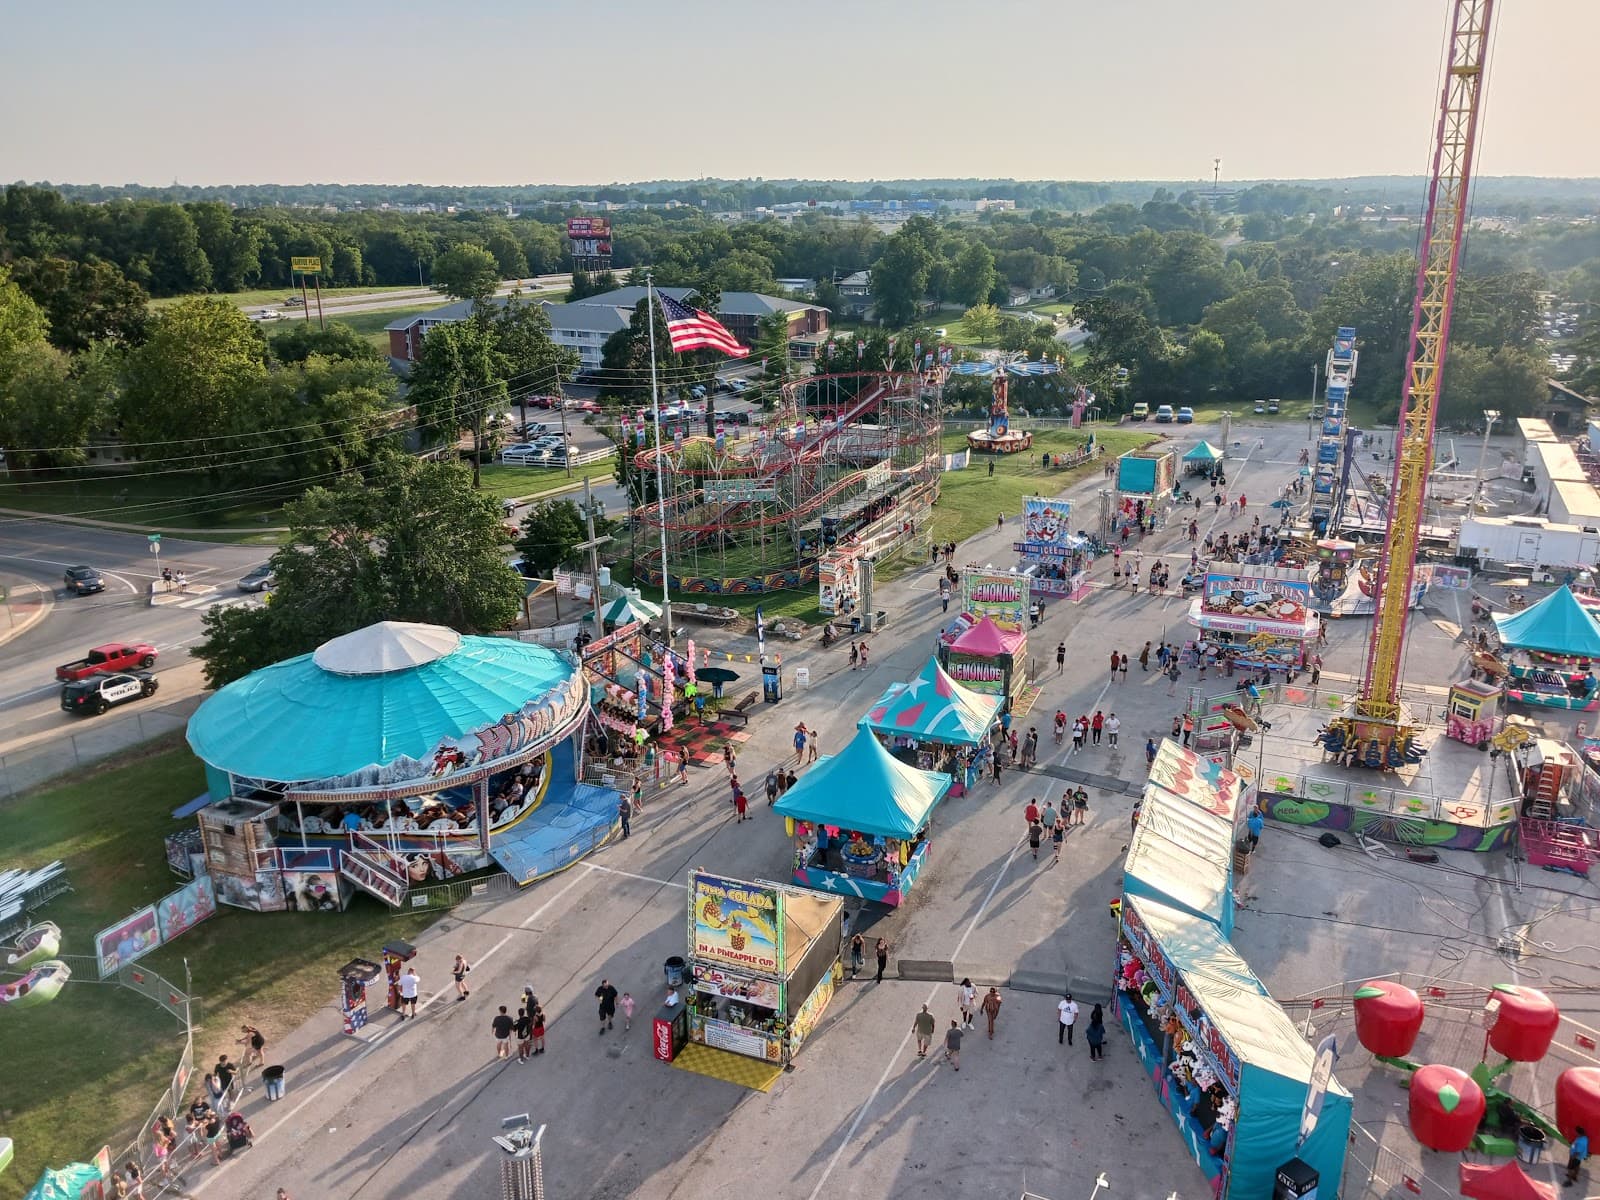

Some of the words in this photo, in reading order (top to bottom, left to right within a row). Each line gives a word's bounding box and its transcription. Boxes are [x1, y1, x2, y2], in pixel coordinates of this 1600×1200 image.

[971, 583, 1021, 603] LEMONADE
[1262, 579, 1305, 603] CAKES
[948, 662, 1002, 682] LEMONADE
[110, 685, 140, 697] POLICE
[727, 889, 774, 910] COLADA
[717, 948, 757, 963] PINEAPPLE
[758, 958, 774, 967] CUP
[694, 966, 723, 983] Dole
[656, 1022, 670, 1059] Coca-Cola
